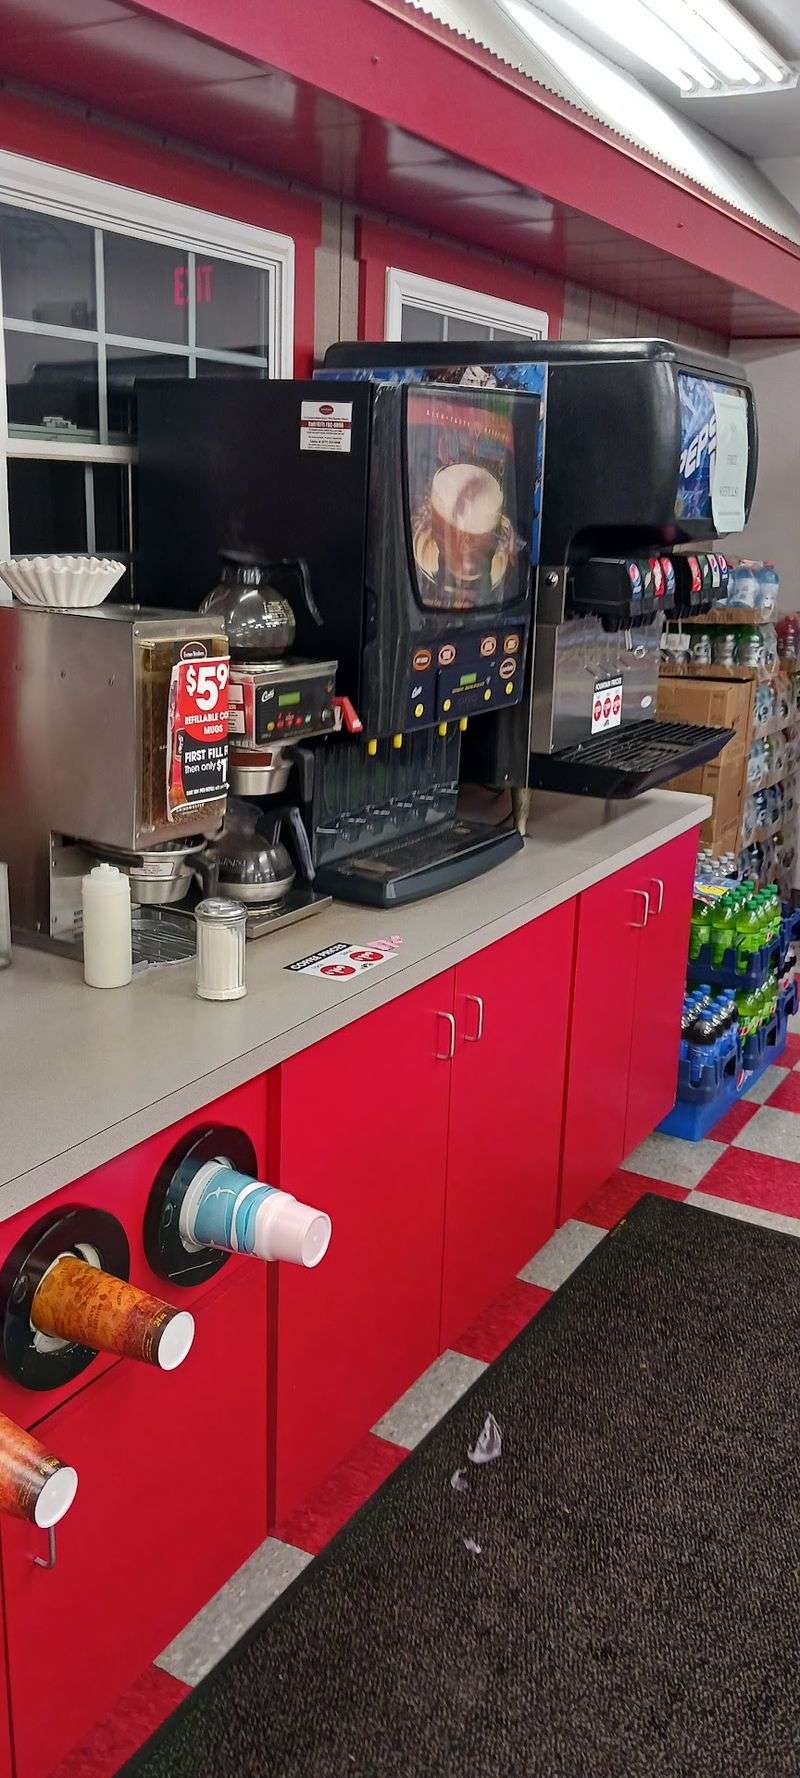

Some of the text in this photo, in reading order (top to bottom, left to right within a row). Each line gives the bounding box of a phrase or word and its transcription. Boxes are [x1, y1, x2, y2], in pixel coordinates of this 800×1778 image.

[174, 265, 213, 305] EIT
[679, 412, 718, 479] PEPS
[184, 713, 219, 725] REFILLABLE
[203, 724, 223, 735] MUGS
[184, 749, 206, 764] FIRST
[207, 747, 223, 759] FILL
[201, 761, 217, 772] only
[290, 955, 321, 970] COFFEE
[317, 944, 347, 958] PRICES
